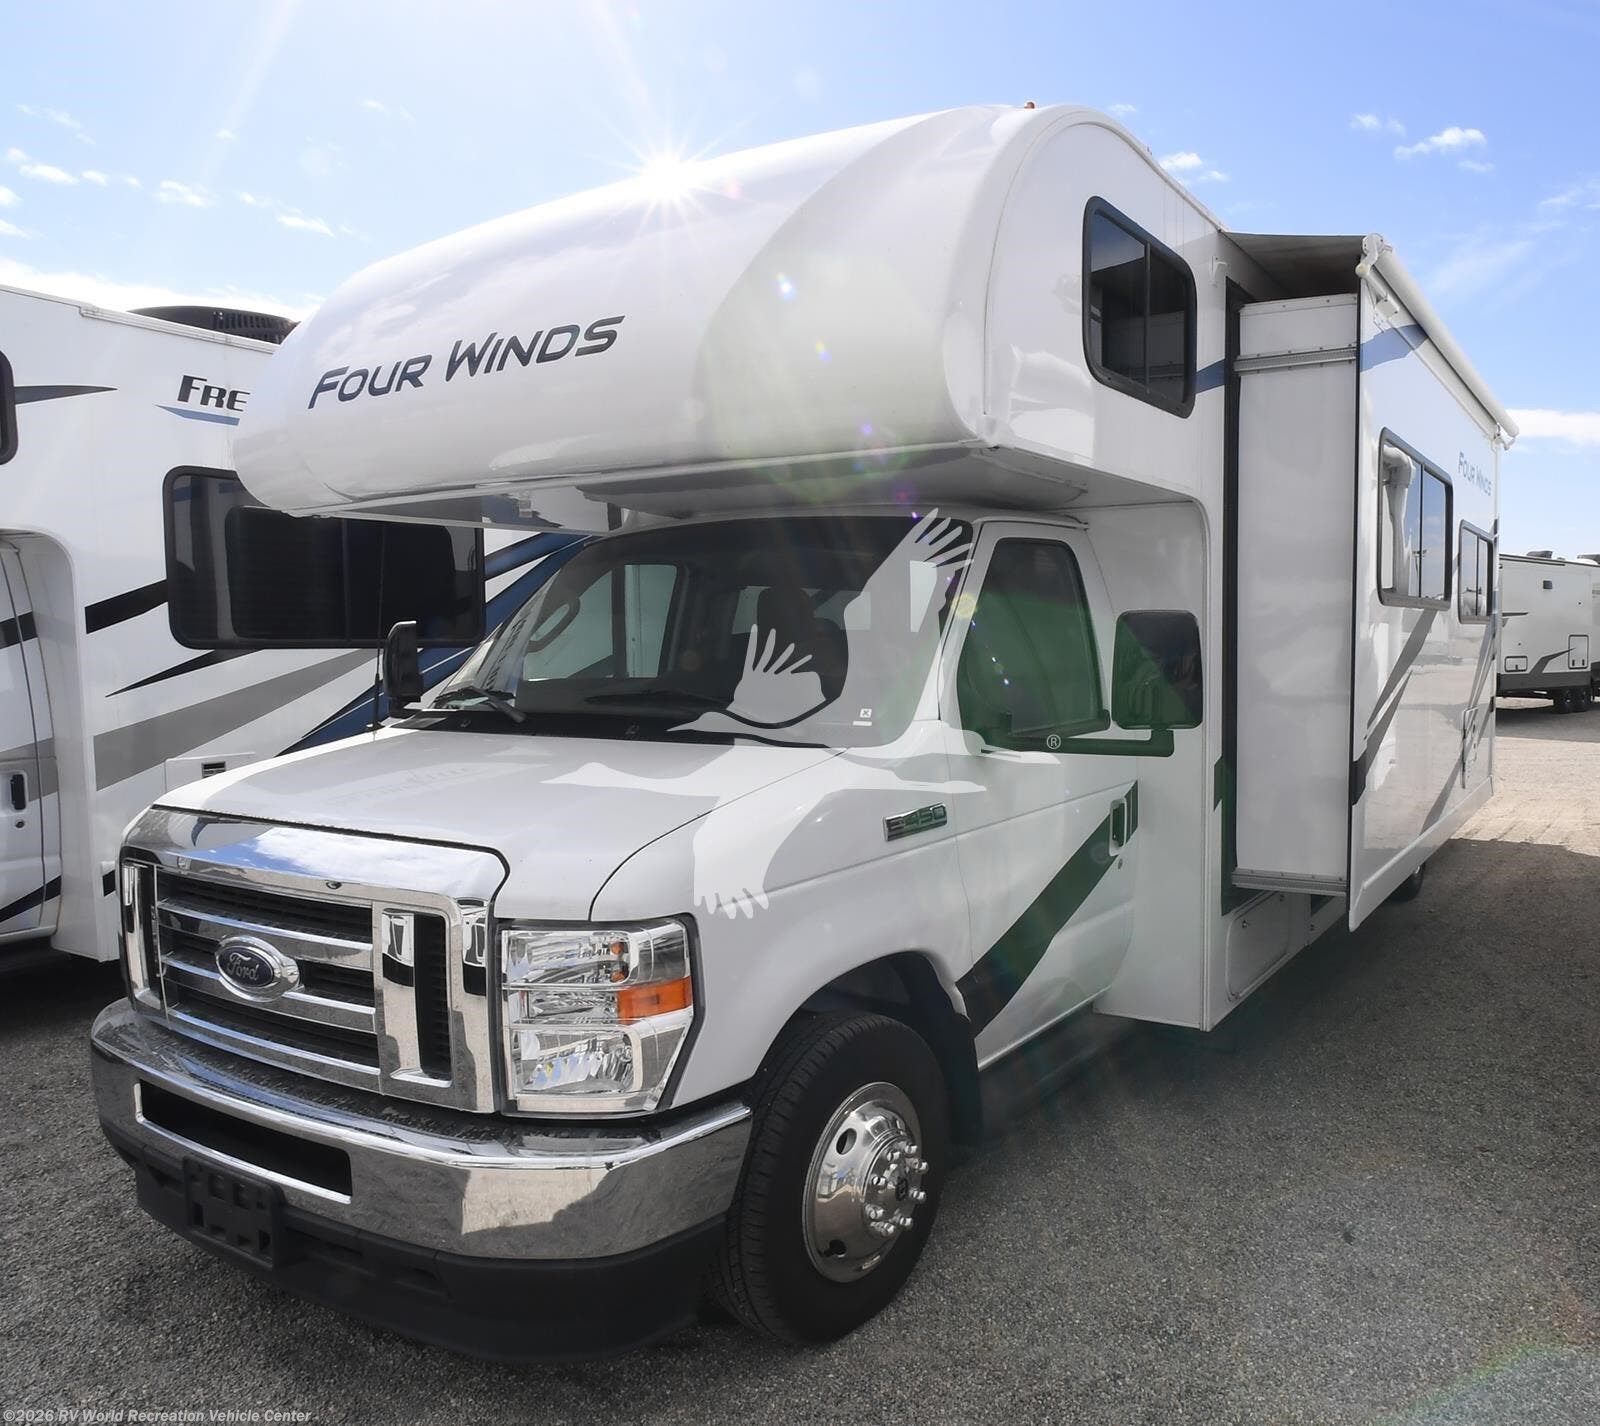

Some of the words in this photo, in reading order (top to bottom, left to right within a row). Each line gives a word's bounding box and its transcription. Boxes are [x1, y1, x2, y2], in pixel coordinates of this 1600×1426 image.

[308, 354, 432, 410] FOUR
[445, 315, 625, 382] WINDS
[1458, 451, 1476, 485] FOUR
[1475, 465, 1492, 497] WINDS
[226, 952, 260, 981] Ford
